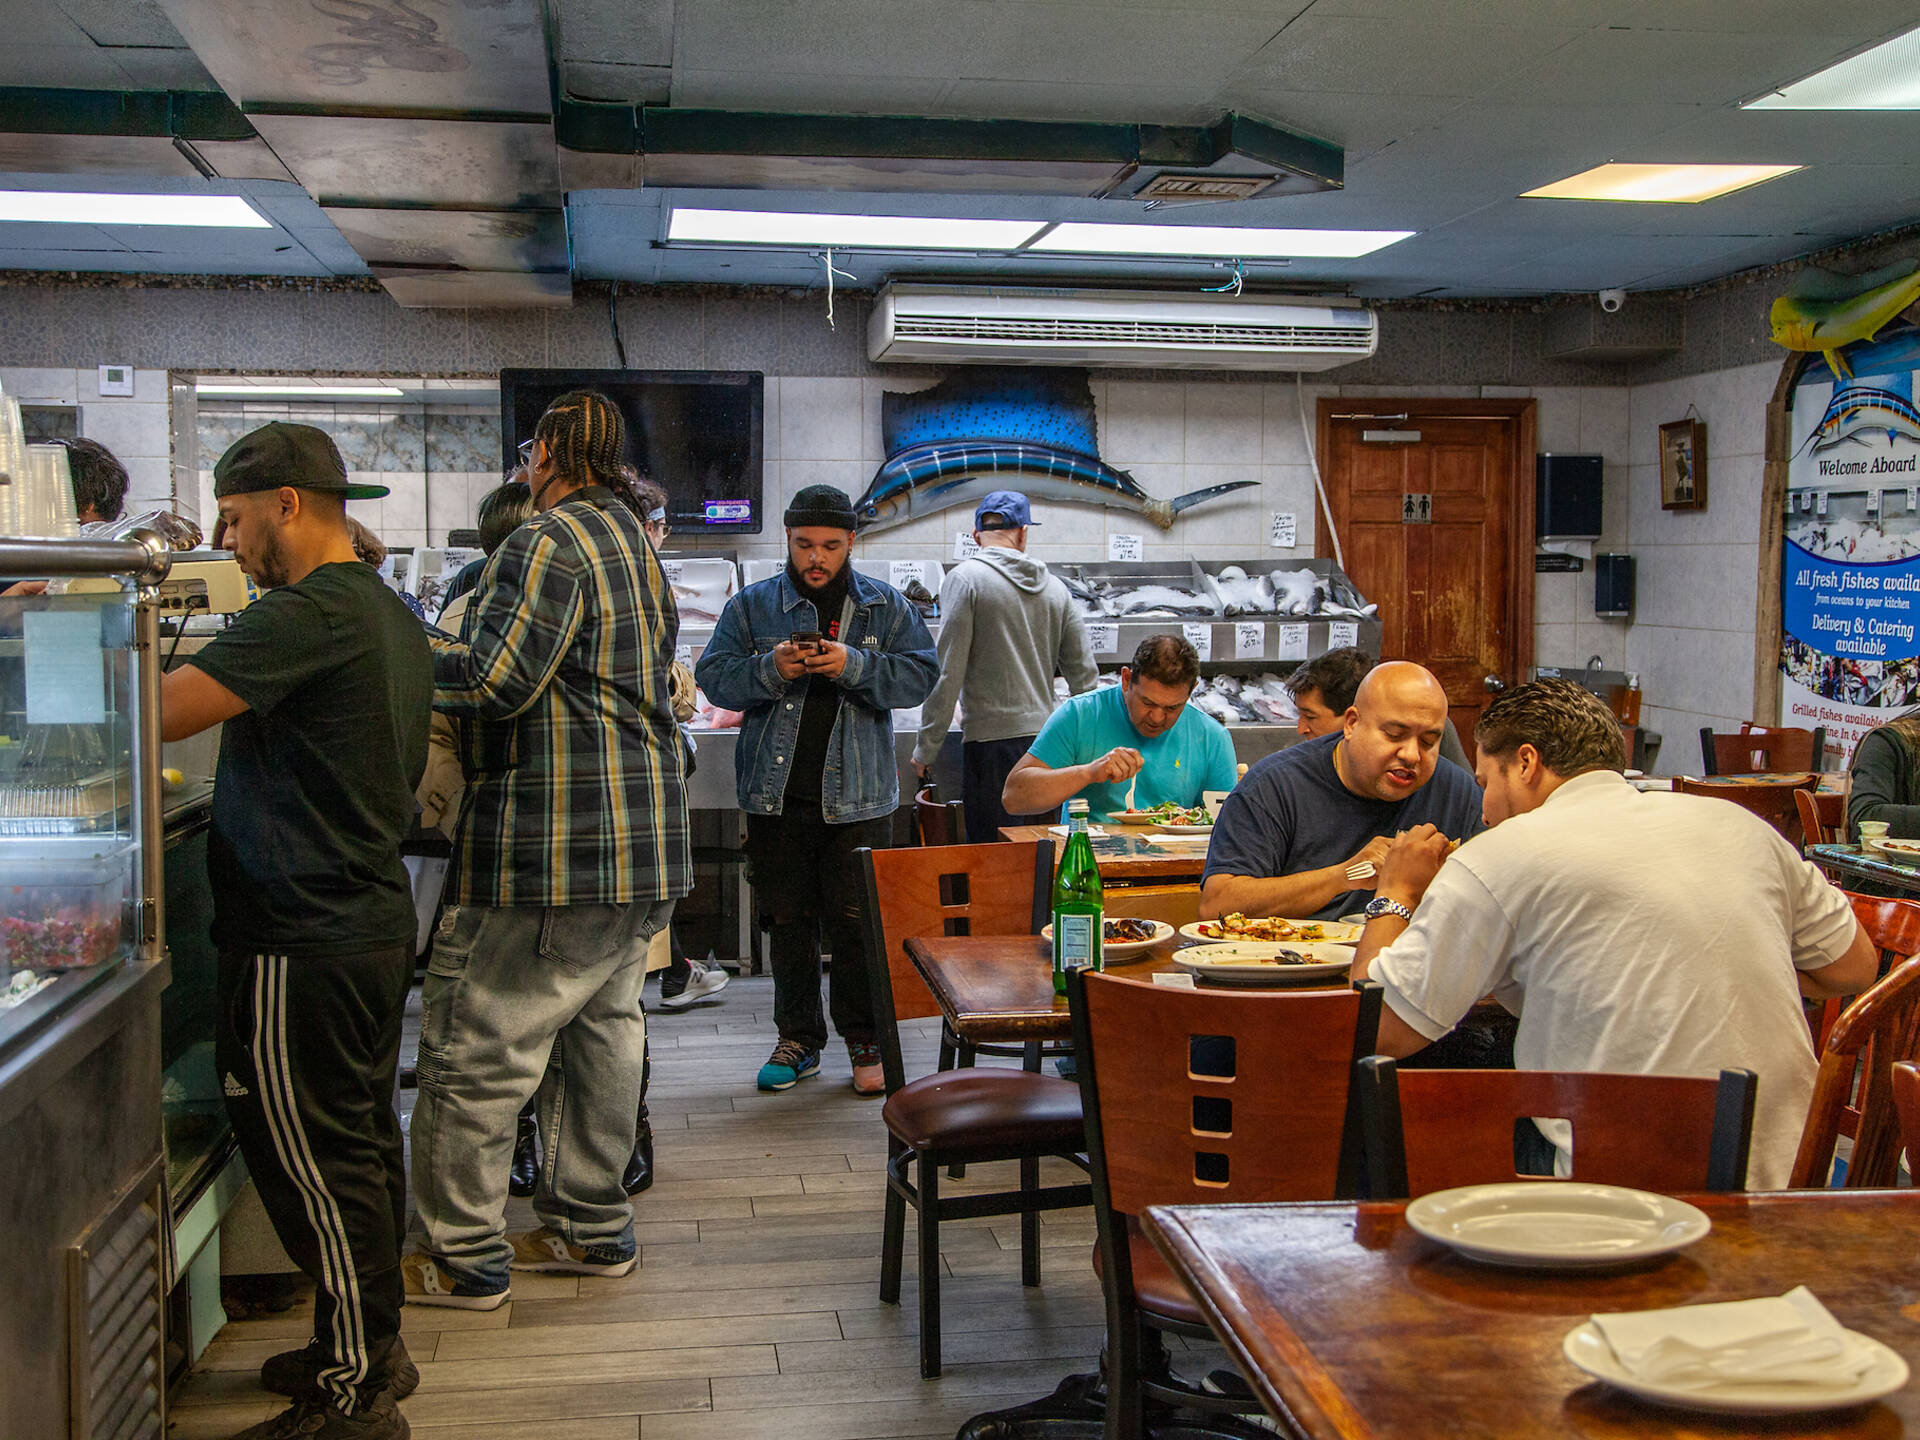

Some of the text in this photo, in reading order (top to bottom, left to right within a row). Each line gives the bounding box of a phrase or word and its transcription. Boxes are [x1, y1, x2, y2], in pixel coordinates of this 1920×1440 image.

[1819, 454, 1917, 476] Welcome Aboard
[1795, 569, 1810, 586] All
[1810, 570, 1838, 590] fresh
[1838, 571, 1880, 592] fishes
[1815, 592, 1910, 610] from oceans to your kitchen
[1812, 613, 1914, 643] Delivery & Catering
[1835, 636, 1887, 656] available
[1792, 703, 1818, 718] Grilled
[1818, 707, 1843, 723] fishes
[1844, 712, 1882, 727] available
[1821, 724, 1839, 738] ine
[1840, 727, 1849, 739] In
[1823, 743, 1847, 759] amily
